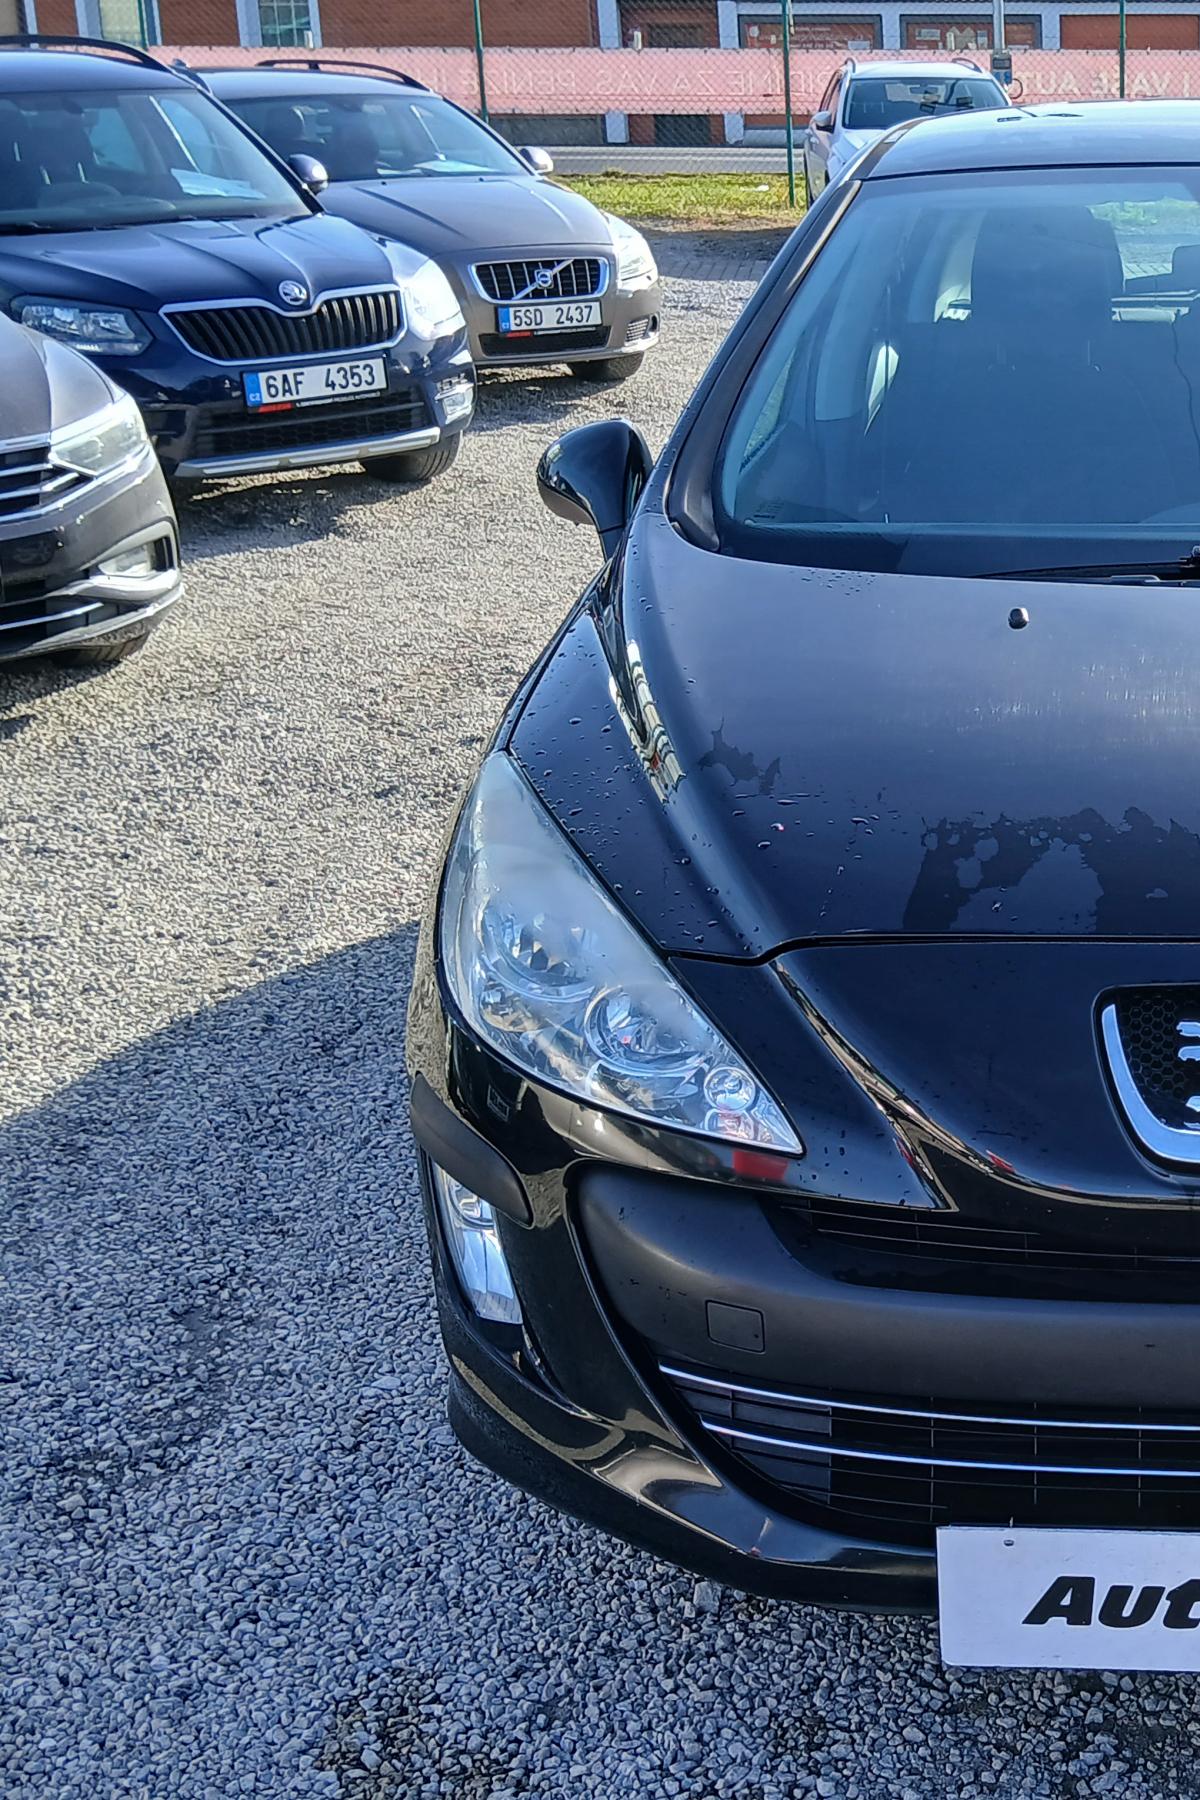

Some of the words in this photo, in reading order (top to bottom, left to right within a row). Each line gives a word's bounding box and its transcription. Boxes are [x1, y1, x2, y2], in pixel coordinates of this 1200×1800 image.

[513, 309, 543, 327] 5SD
[555, 305, 592, 325] 2437
[265, 371, 305, 398] 6AF
[324, 363, 376, 392] 4353
